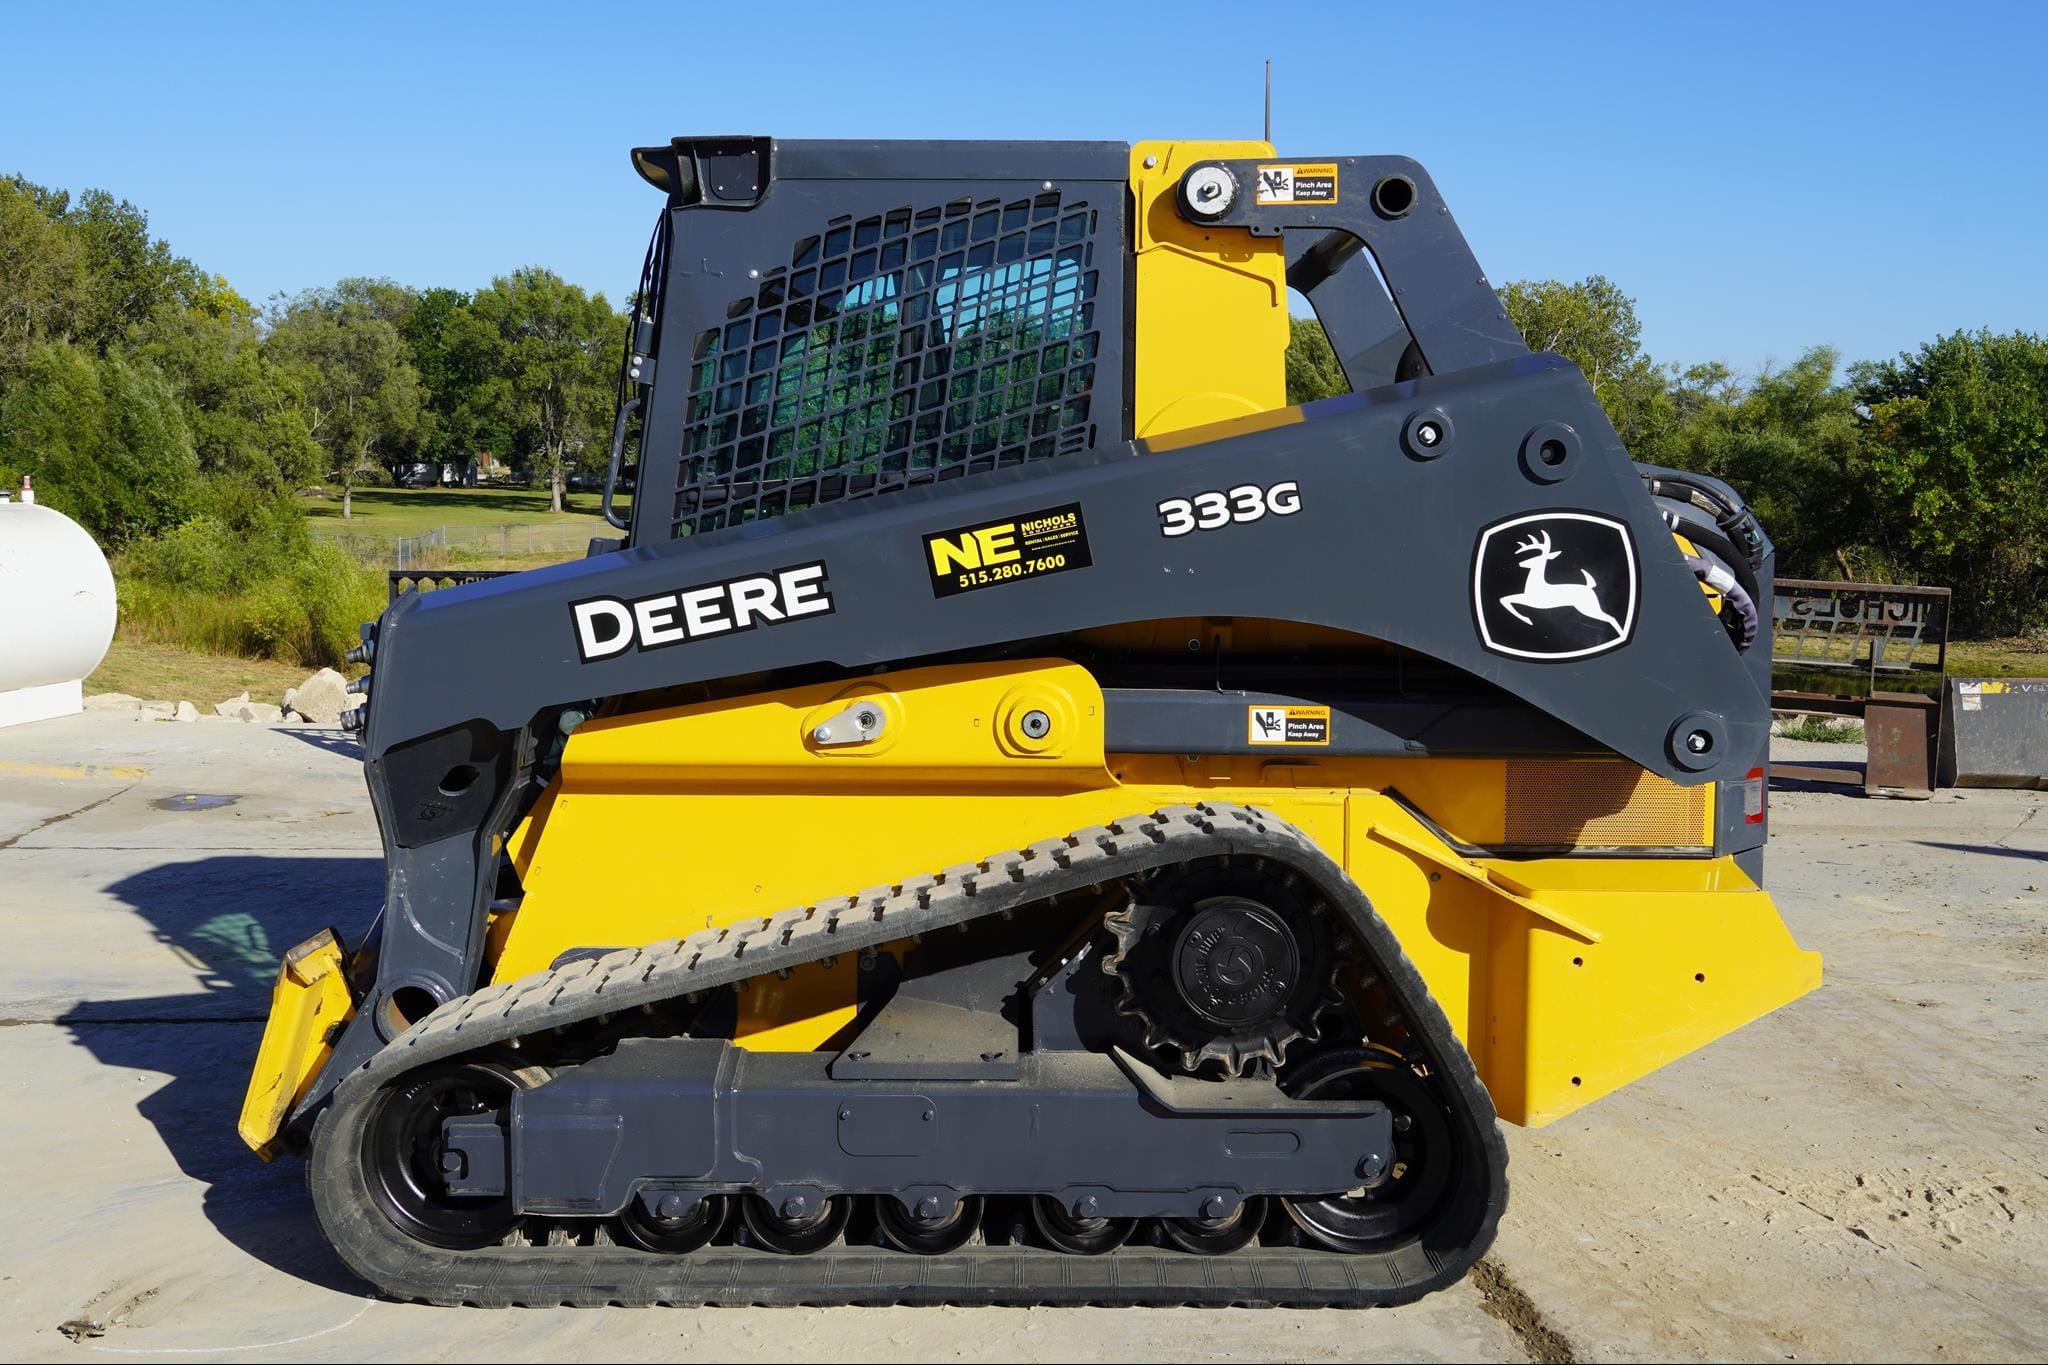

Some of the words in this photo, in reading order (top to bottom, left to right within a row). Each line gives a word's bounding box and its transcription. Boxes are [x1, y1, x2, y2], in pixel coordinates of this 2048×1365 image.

[1295, 181, 1315, 189] Pinch
[1021, 512, 1076, 532] NICHOLS
[1158, 482, 1301, 536] 333G
[930, 523, 1021, 577] NE
[1024, 538, 1043, 546] RENTAL
[1044, 534, 1059, 542] SALES
[1060, 530, 1079, 538] SERVICE
[959, 554, 1066, 588] 515.280.7600
[575, 566, 829, 658] DEERE
